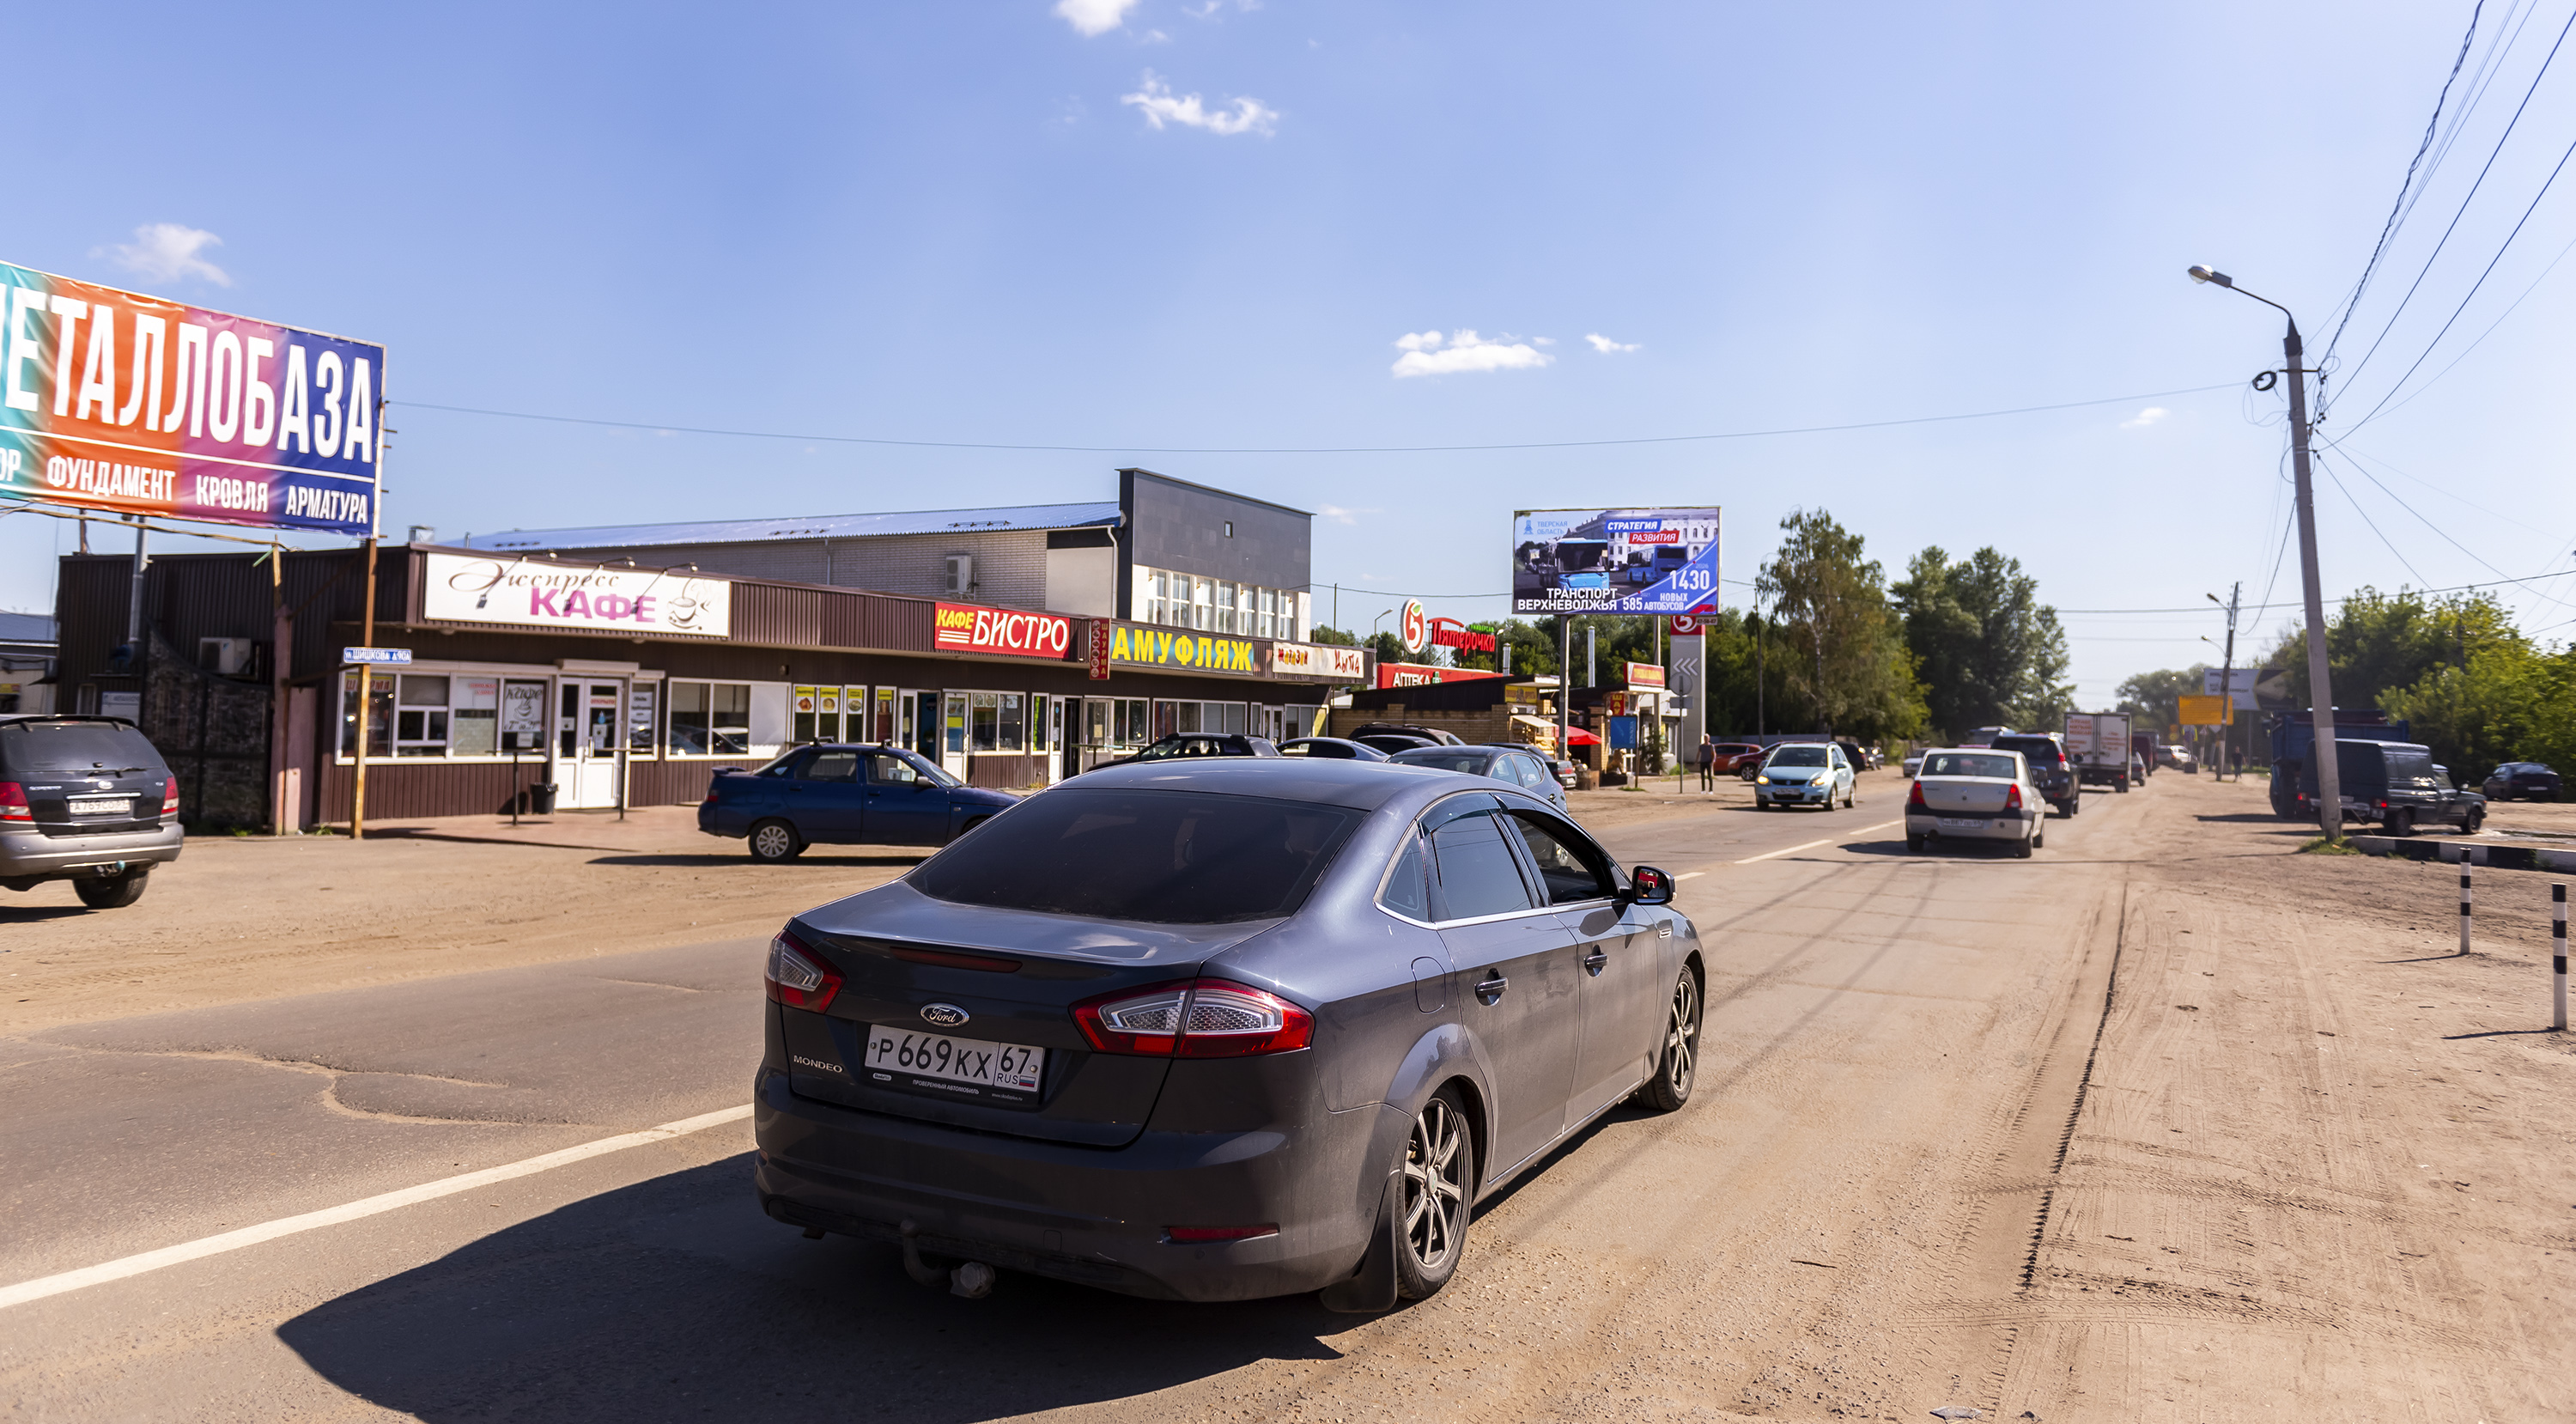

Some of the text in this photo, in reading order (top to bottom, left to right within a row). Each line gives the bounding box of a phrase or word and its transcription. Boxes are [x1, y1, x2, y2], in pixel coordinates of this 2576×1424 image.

[0, 283, 373, 463] ЕТАЛЛОБАЗА
[46, 454, 176, 502] ФУНДАМЕНТ
[195, 475, 269, 513] КРОВЛЯ
[285, 485, 368, 525] АРМАТУРА
[1607, 520, 1658, 531] СТРАТЕГИЯ
[1631, 532, 1676, 542] РАЗВИТИЯ
[1669, 569, 1710, 590] 1430
[1546, 588, 1618, 599] ТРАНСПОРТ
[1660, 593, 1688, 601] НОВЫХ
[529, 587, 657, 623] КАФЕ
[1517, 599, 1617, 611] ВЕРХНЕВОЛЖЬЯ
[1623, 597, 1685, 611] 585 АВТОБУСОВ
[936, 609, 1068, 652] КАФЕ БИСТРО
[1427, 617, 1496, 656] Пятерочка
[353, 648, 390, 660] ШИШКОВА
[1100, 623, 1109, 674] ШАУРМА
[1111, 627, 1253, 672] АМУФЛЯЖ
[1393, 672, 1431, 687] АПТЕКА
[929, 1007, 957, 1023] Ford
[793, 1055, 843, 1073] MONDEO
[877, 1034, 1031, 1080] Р669КХ 67
[912, 1079, 980, 1095] ПРОВЕРЕННЫЙ АВТОМОБИЛЬ
[996, 1073, 1018, 1085] RUS
